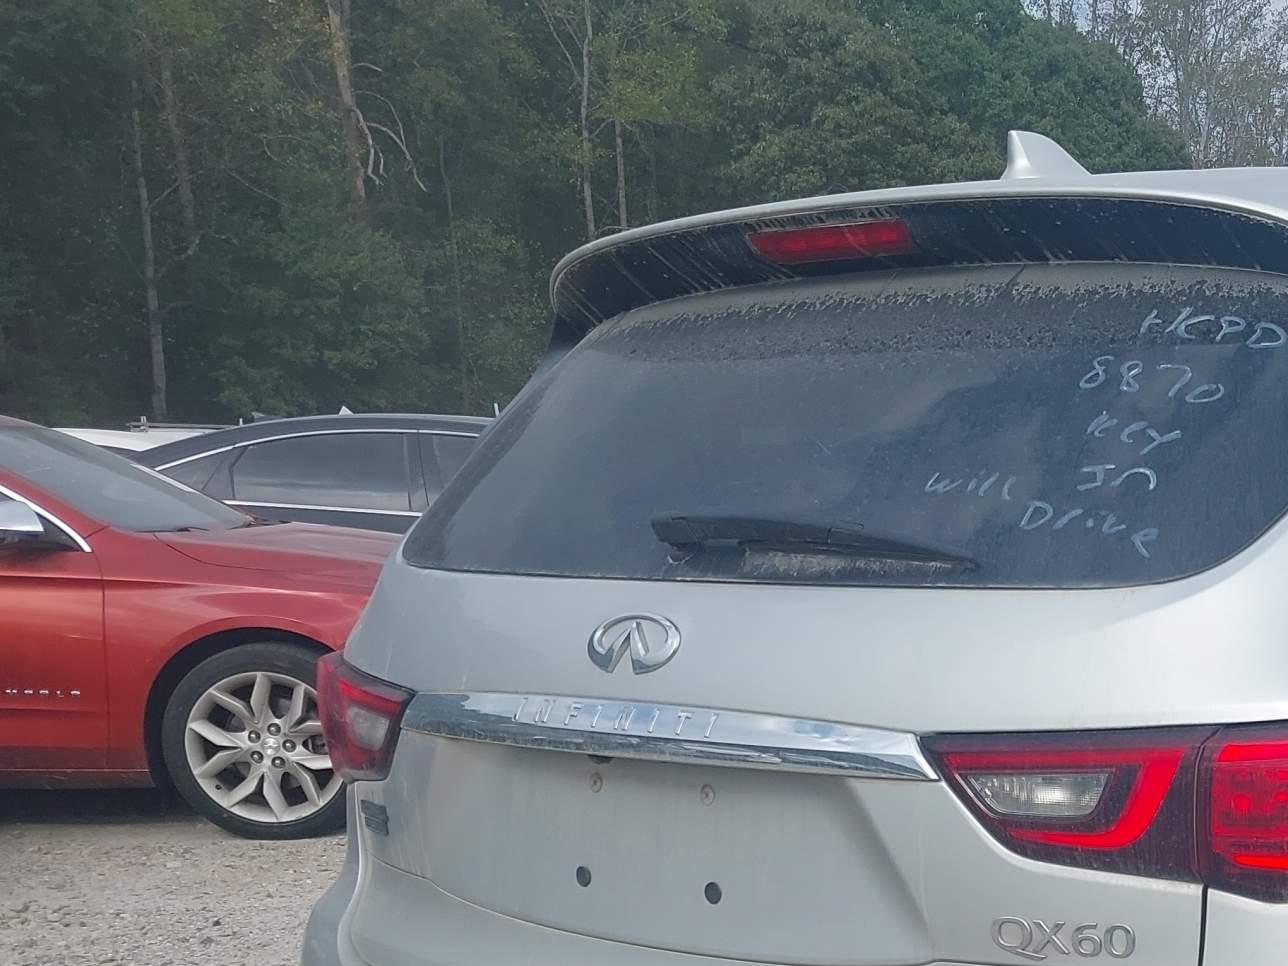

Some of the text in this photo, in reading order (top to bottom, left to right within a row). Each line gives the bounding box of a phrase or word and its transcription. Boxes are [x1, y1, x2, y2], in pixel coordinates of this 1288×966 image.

[1079, 355, 1225, 402] 8870
[512, 697, 720, 738] INFINITI
[991, 916, 1136, 961] QX60
